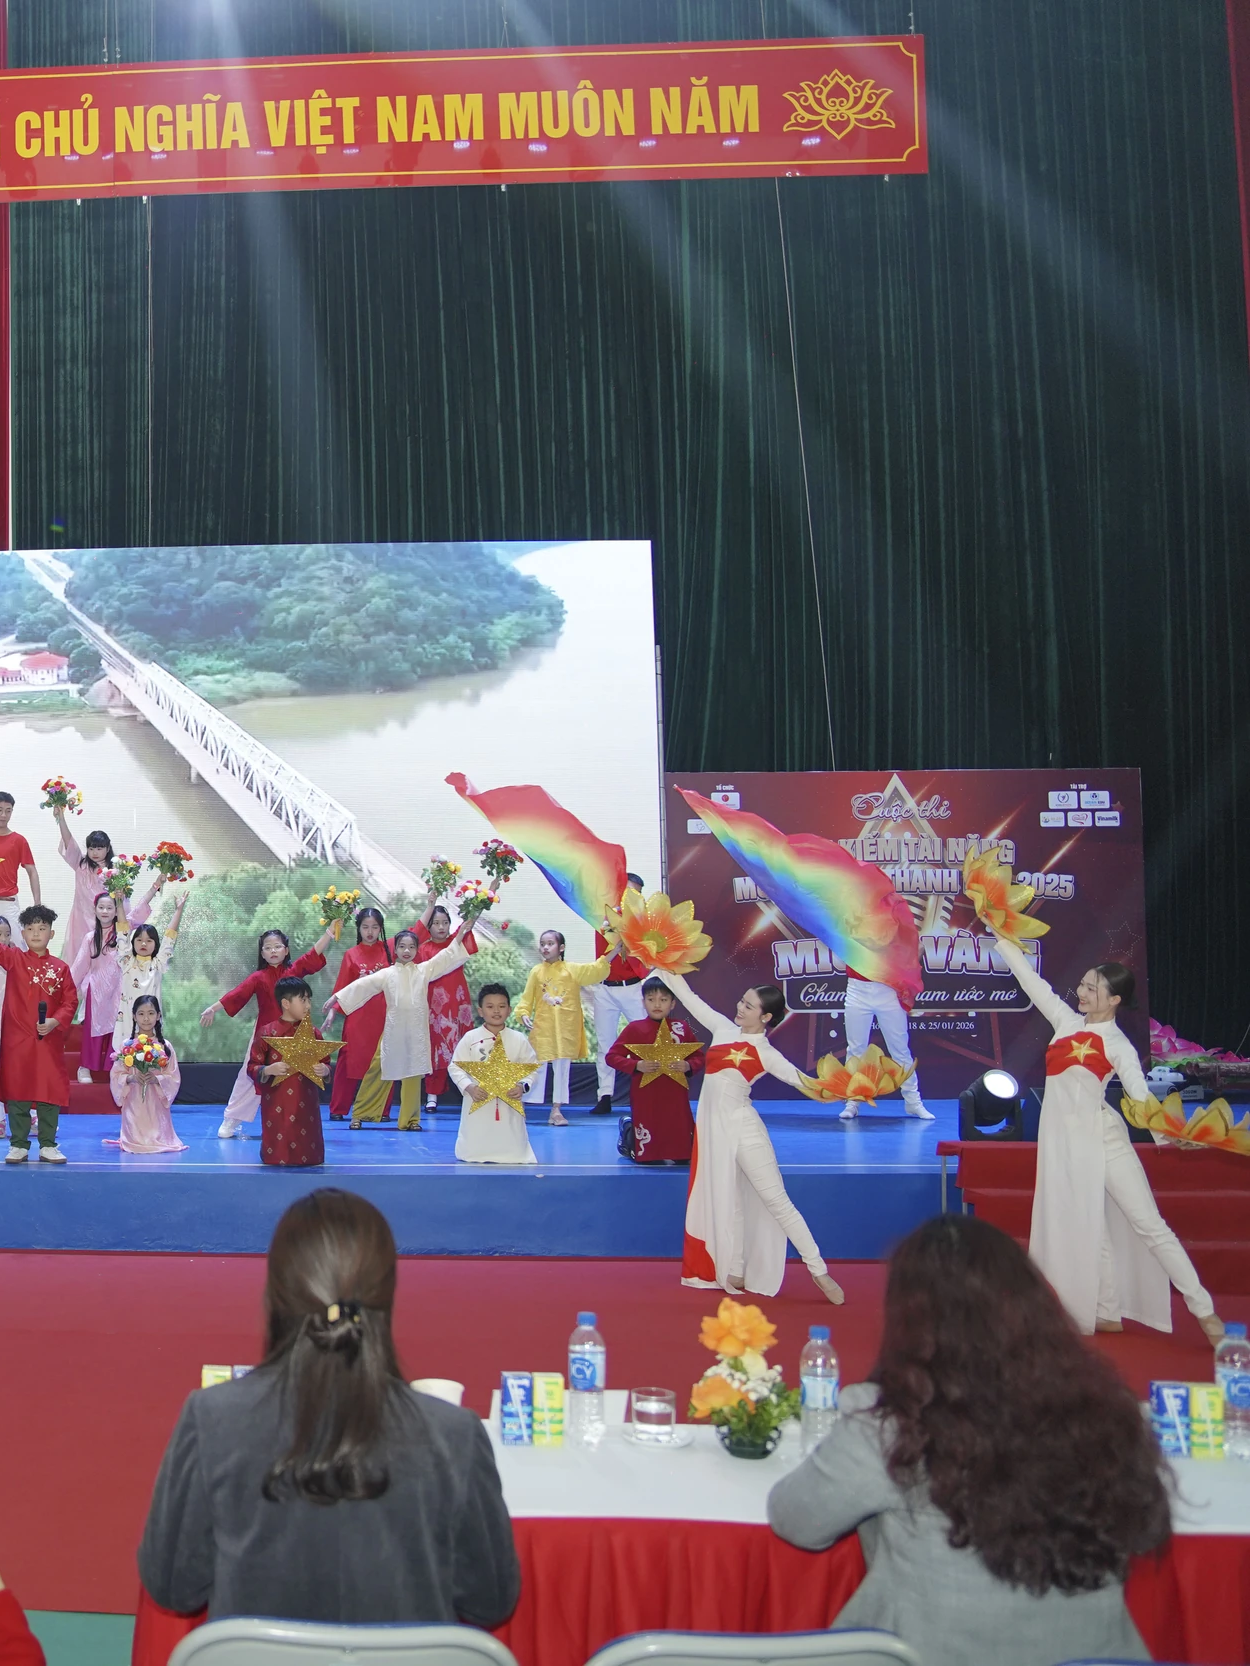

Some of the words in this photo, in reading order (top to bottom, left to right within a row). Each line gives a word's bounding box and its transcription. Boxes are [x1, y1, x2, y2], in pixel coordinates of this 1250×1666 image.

[15, 94, 100, 158] CHỦ
[114, 94, 250, 154] NGHĨA
[263, 89, 361, 155] VIỆT
[376, 93, 485, 144] NAM
[498, 80, 636, 140] MUÔN
[650, 76, 760, 135] NĂM
[851, 793, 914, 822] Cuộc
[916, 795, 951, 820] thi
[903, 834, 943, 863] TÀI
[953, 985, 986, 1001] ước
[989, 988, 1018, 1001] mơ
[918, 1021, 926, 1030] &
[955, 1021, 975, 1030] 2026
[1230, 1382, 1250, 1397] IC
